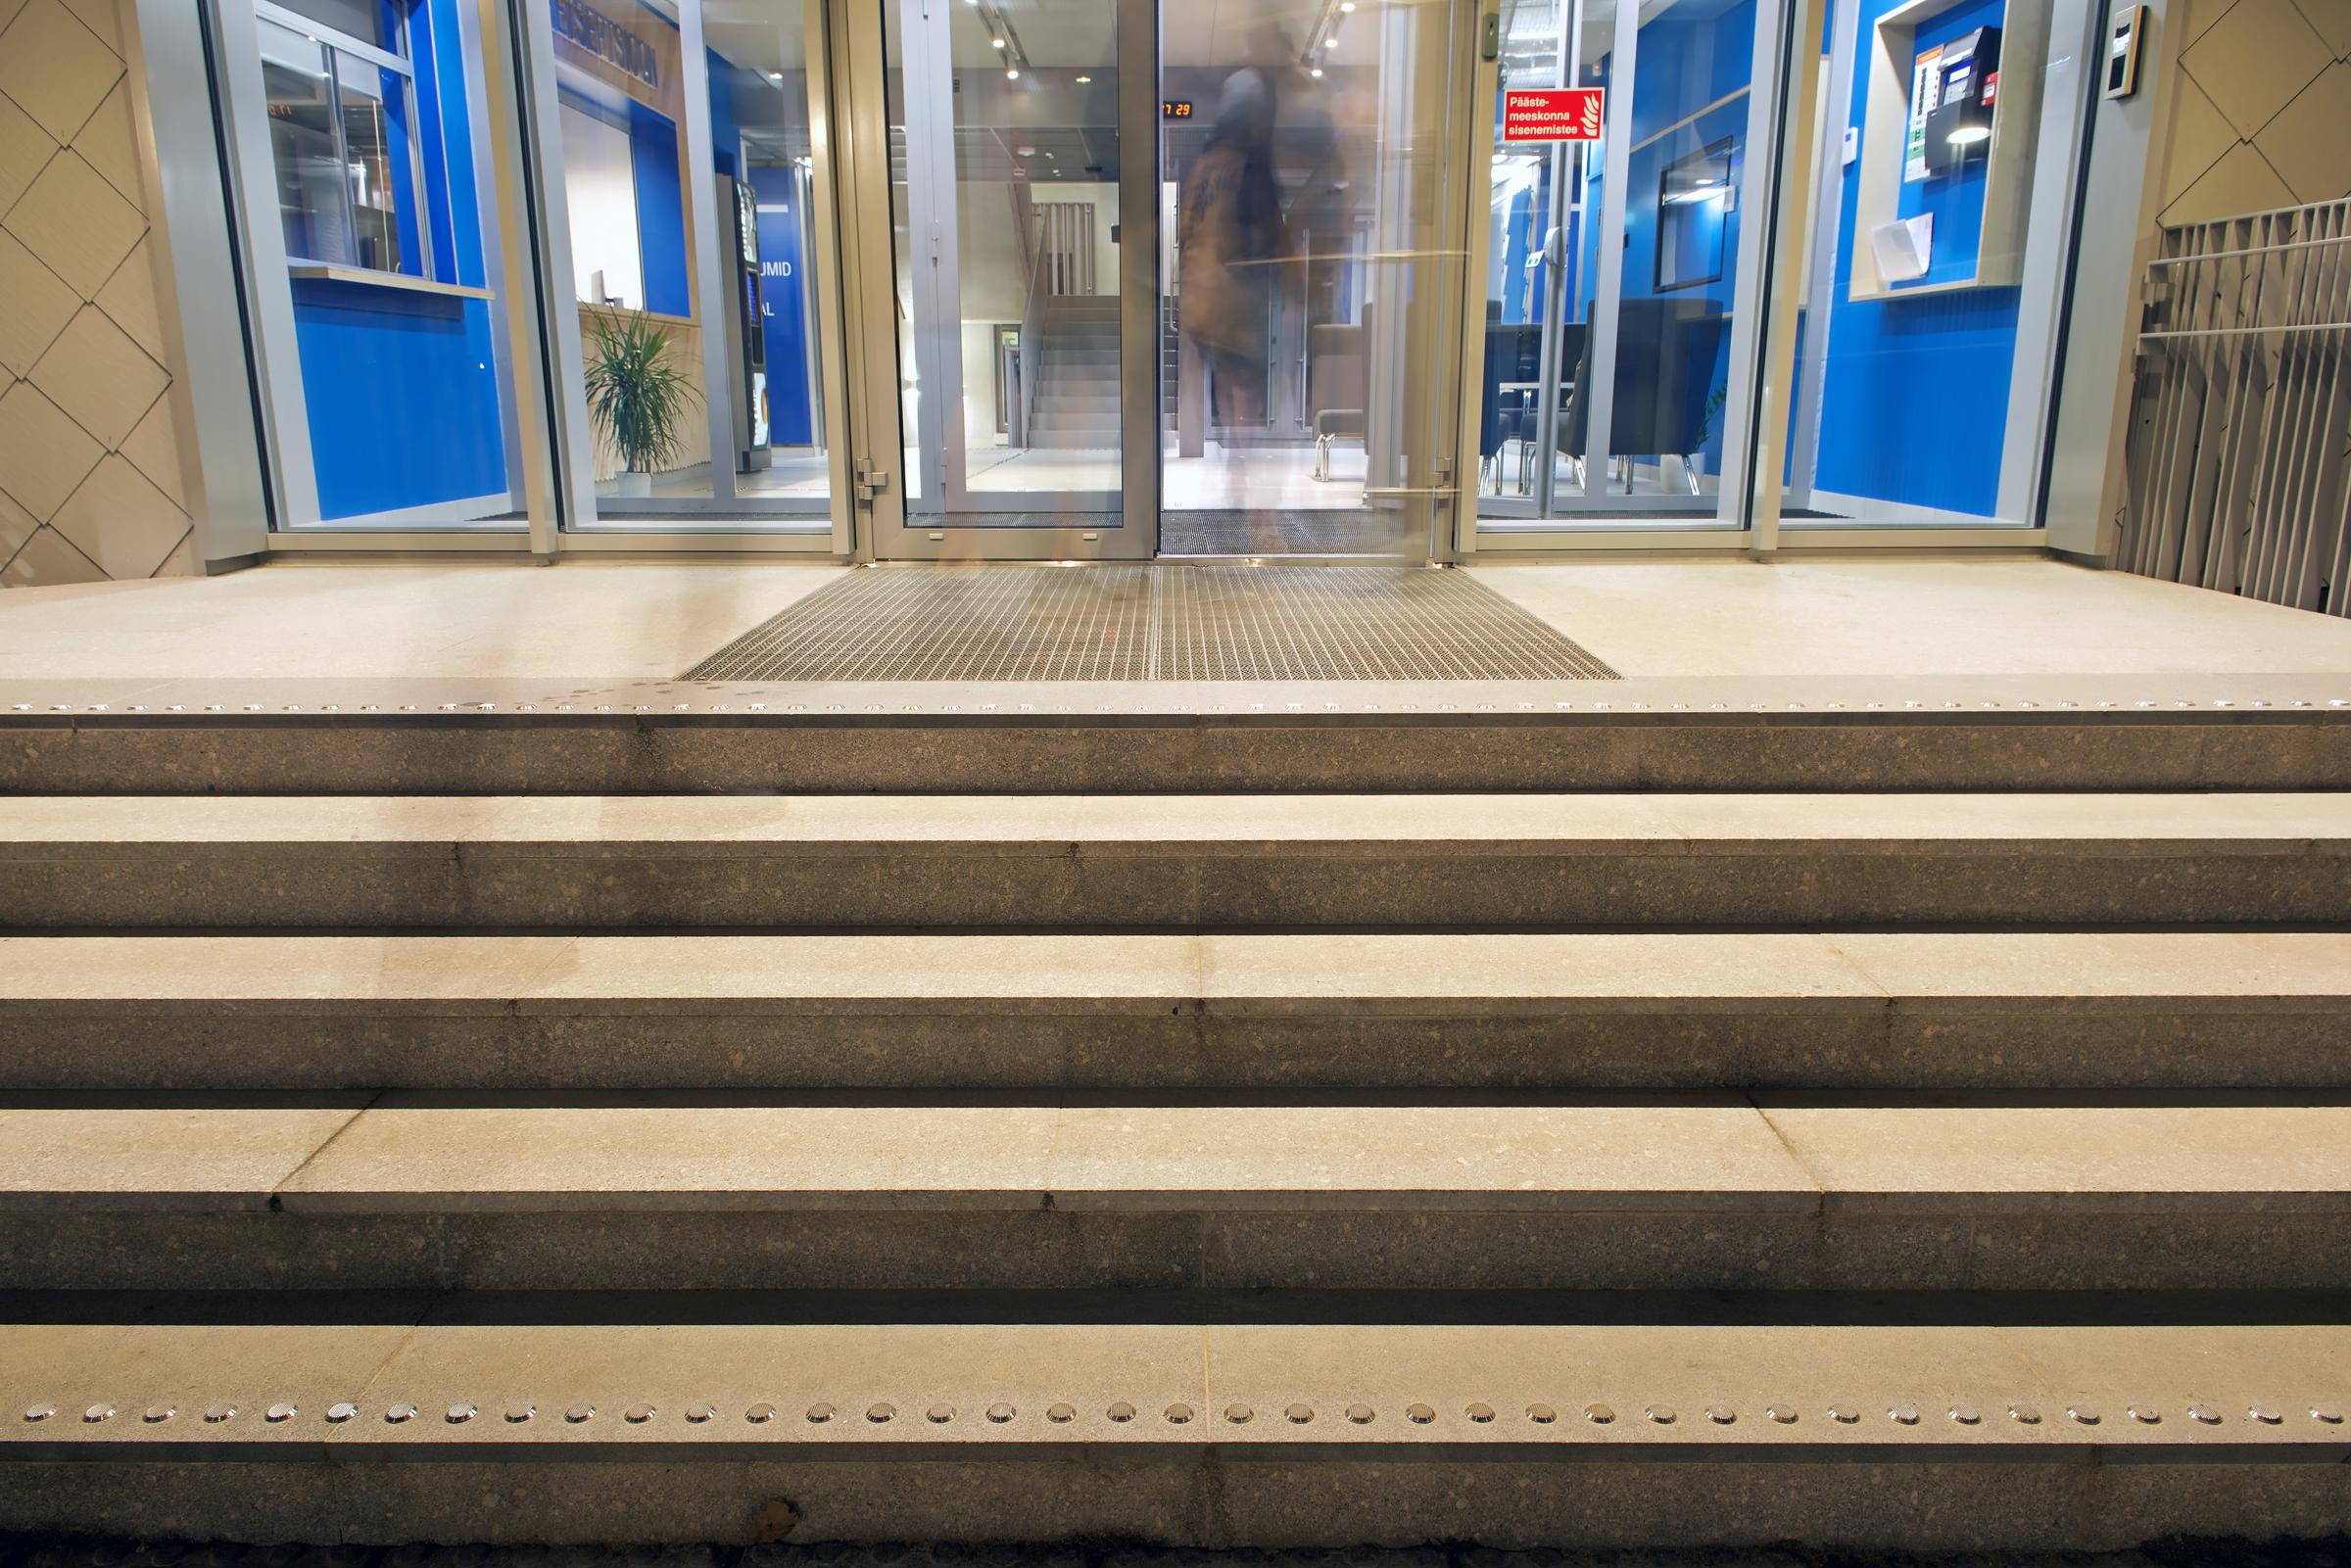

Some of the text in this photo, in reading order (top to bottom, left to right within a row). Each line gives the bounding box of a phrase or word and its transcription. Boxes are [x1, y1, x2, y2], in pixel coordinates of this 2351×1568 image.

[1510, 97, 1550, 107] Pääste-
[1176, 104, 1190, 116] 29
[1510, 111, 1570, 121] meeskonna
[1509, 124, 1578, 135] sisenemistee
